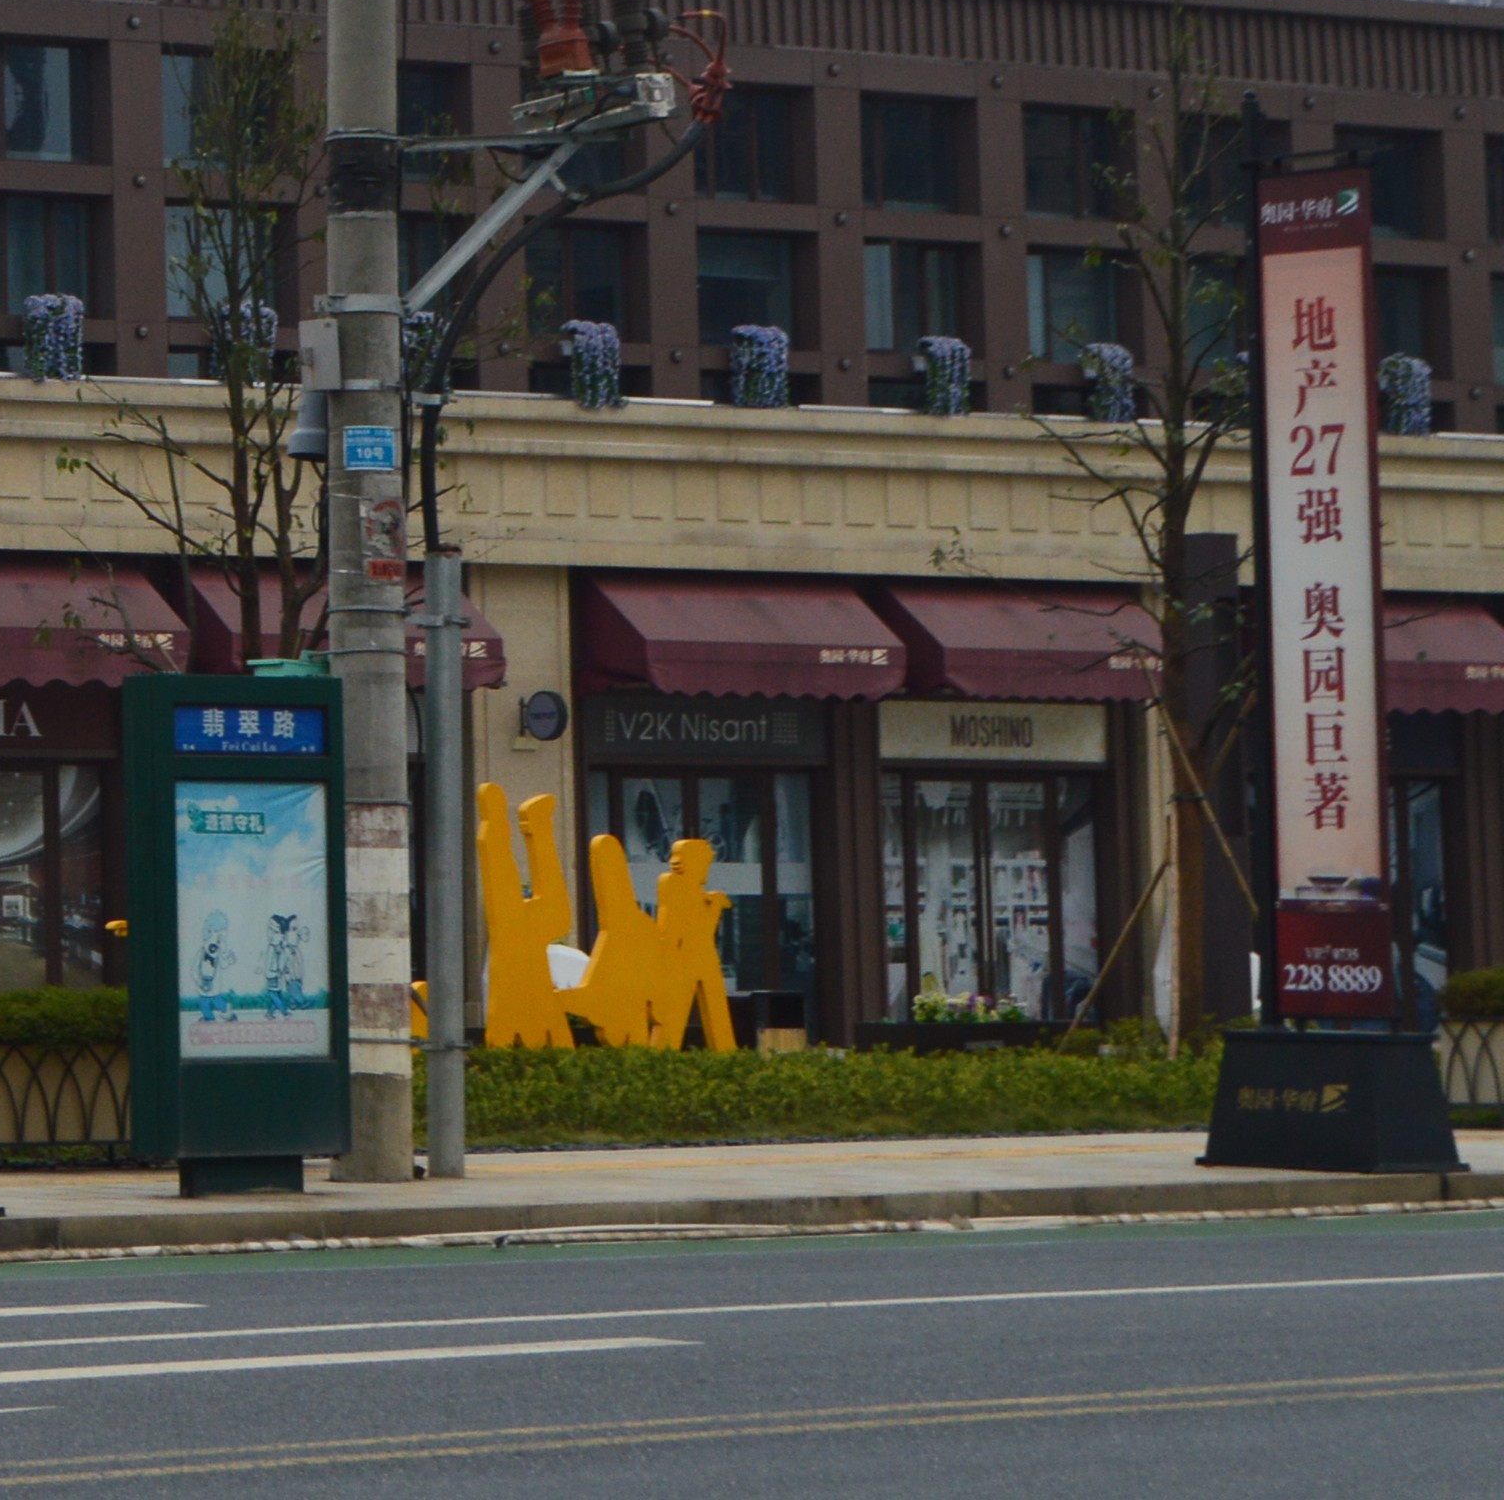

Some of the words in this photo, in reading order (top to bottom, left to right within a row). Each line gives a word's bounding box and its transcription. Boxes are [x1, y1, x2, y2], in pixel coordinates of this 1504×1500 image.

[1289, 297, 1344, 543] 地产27强
[1300, 582, 1350, 830] 奥园巨著
[202, 708, 296, 739] 翡翠路
[619, 712, 673, 740] V2K
[681, 711, 768, 742] Nisant
[950, 714, 1035, 749] MOSHINO
[1283, 963, 1325, 991] 228
[1328, 964, 1383, 993] 8889
